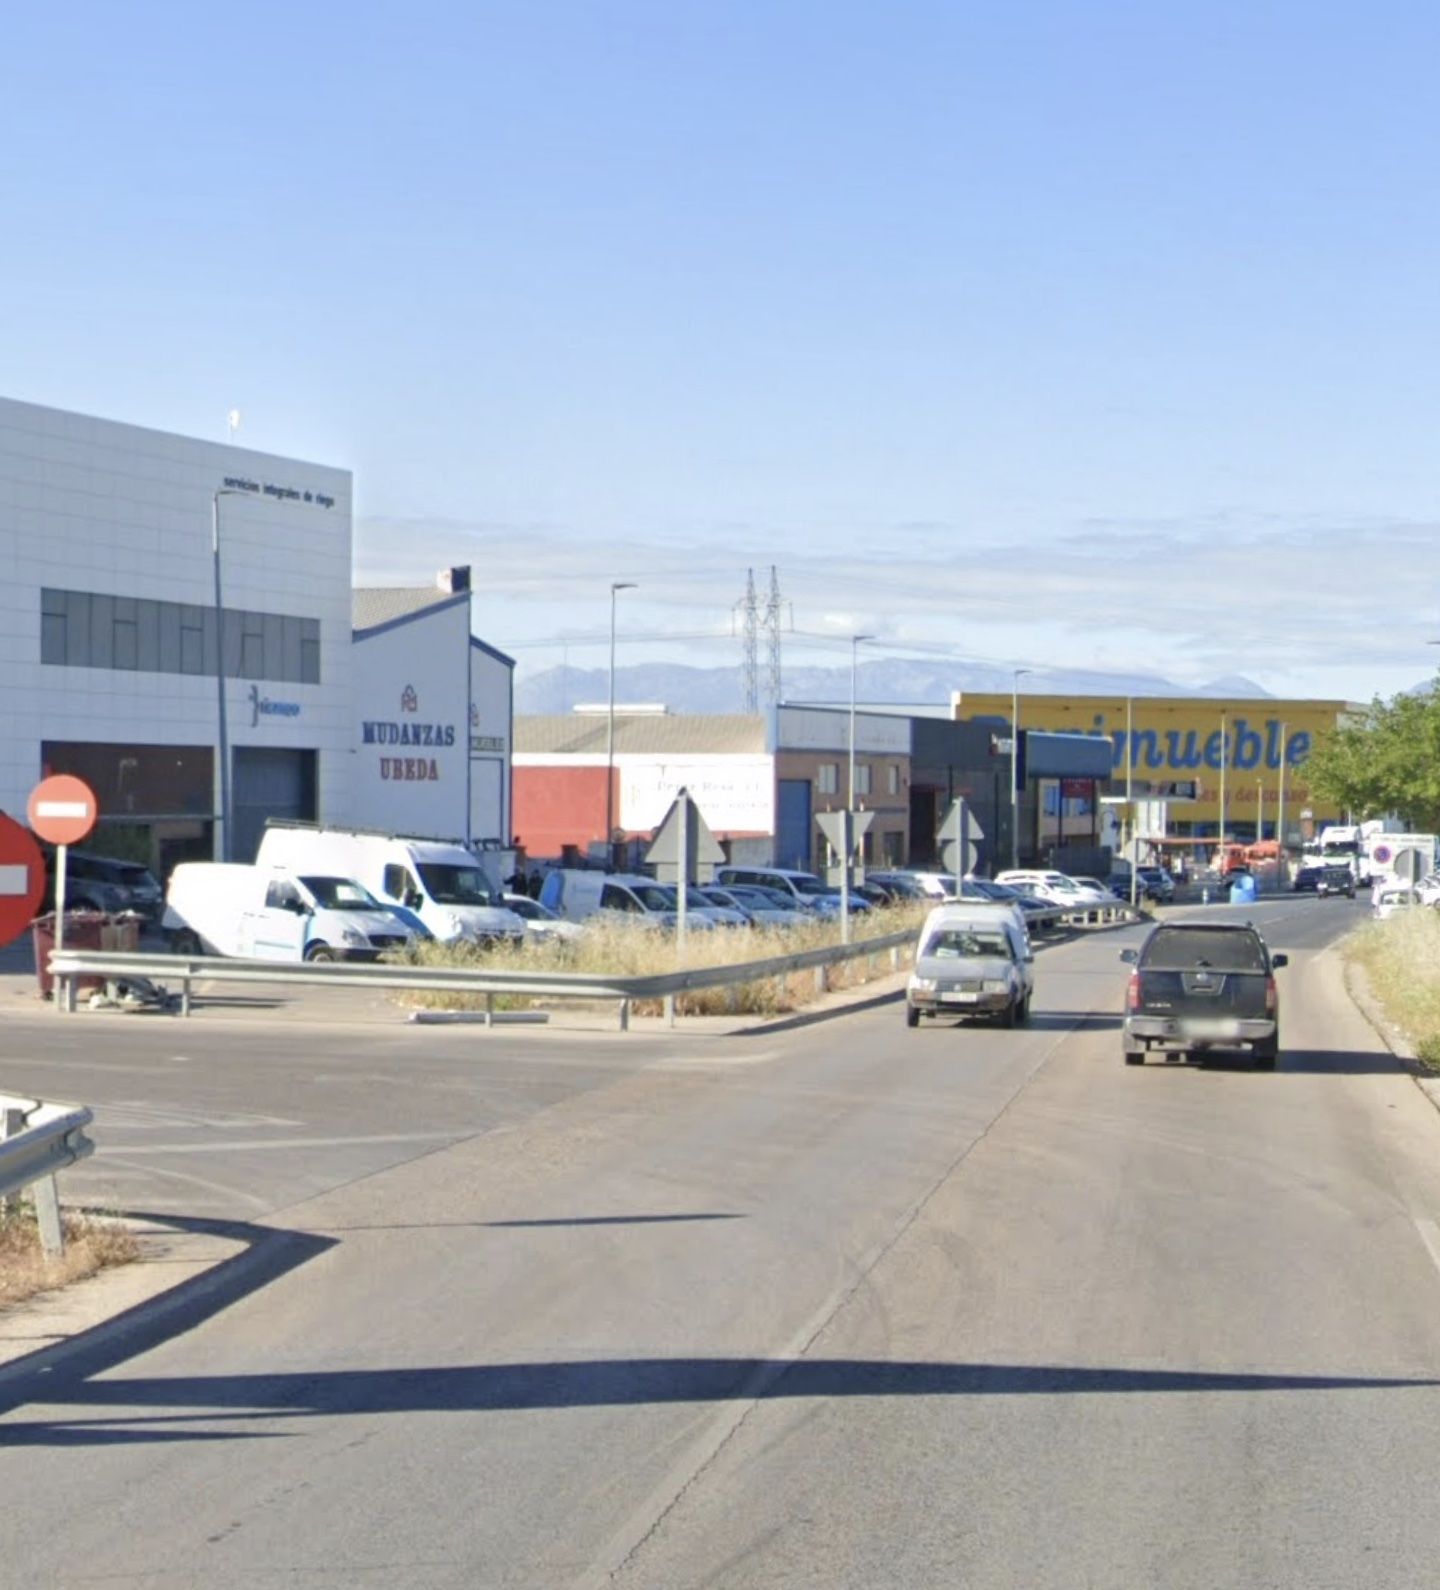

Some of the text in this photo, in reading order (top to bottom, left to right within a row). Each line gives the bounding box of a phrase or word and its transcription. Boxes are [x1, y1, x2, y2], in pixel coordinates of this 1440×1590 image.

[262, 482, 301, 501] integrales
[303, 489, 313, 502] de
[362, 721, 455, 747] MUDANZAS
[379, 757, 439, 781] UBEDA
